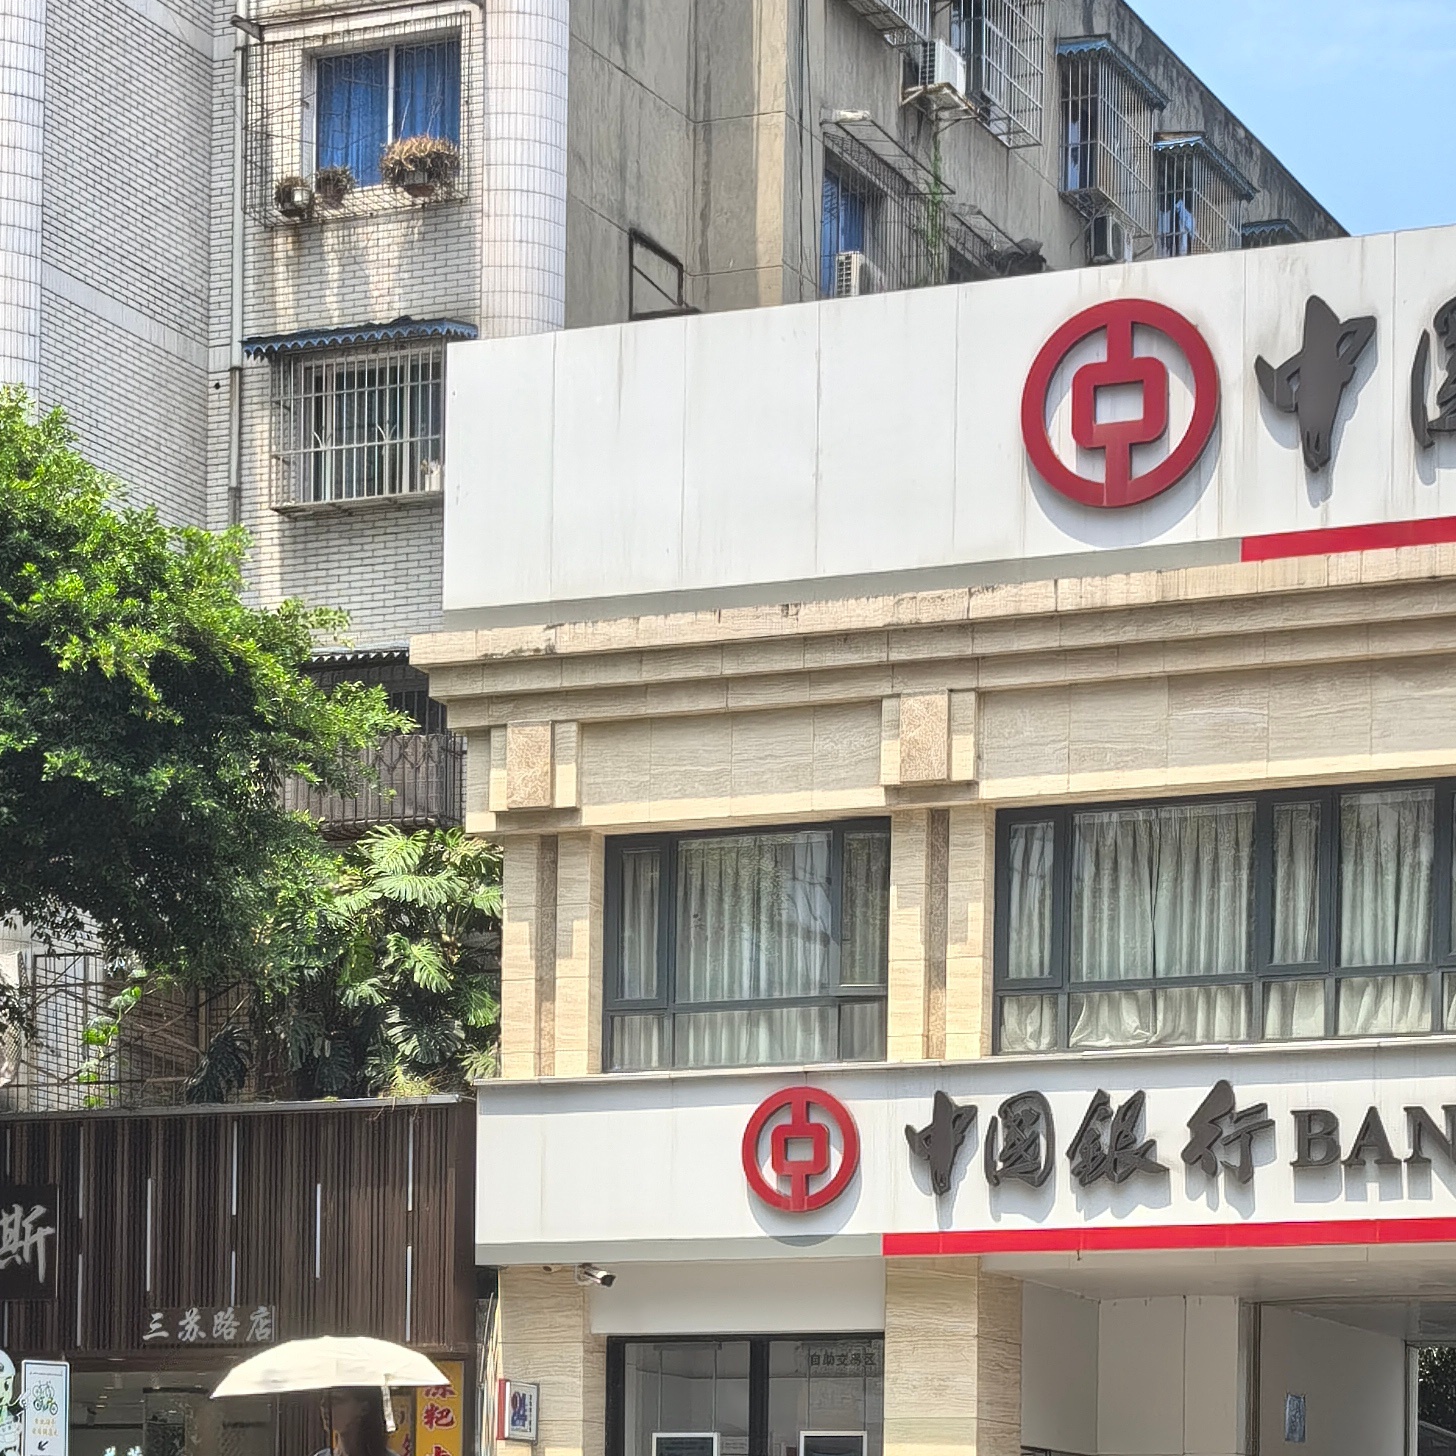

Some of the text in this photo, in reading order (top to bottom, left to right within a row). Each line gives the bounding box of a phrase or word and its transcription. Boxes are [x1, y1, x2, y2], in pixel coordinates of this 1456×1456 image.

[142, 1305, 272, 1342] 三苏路店
[810, 1351, 877, 1366] 自助交易区
